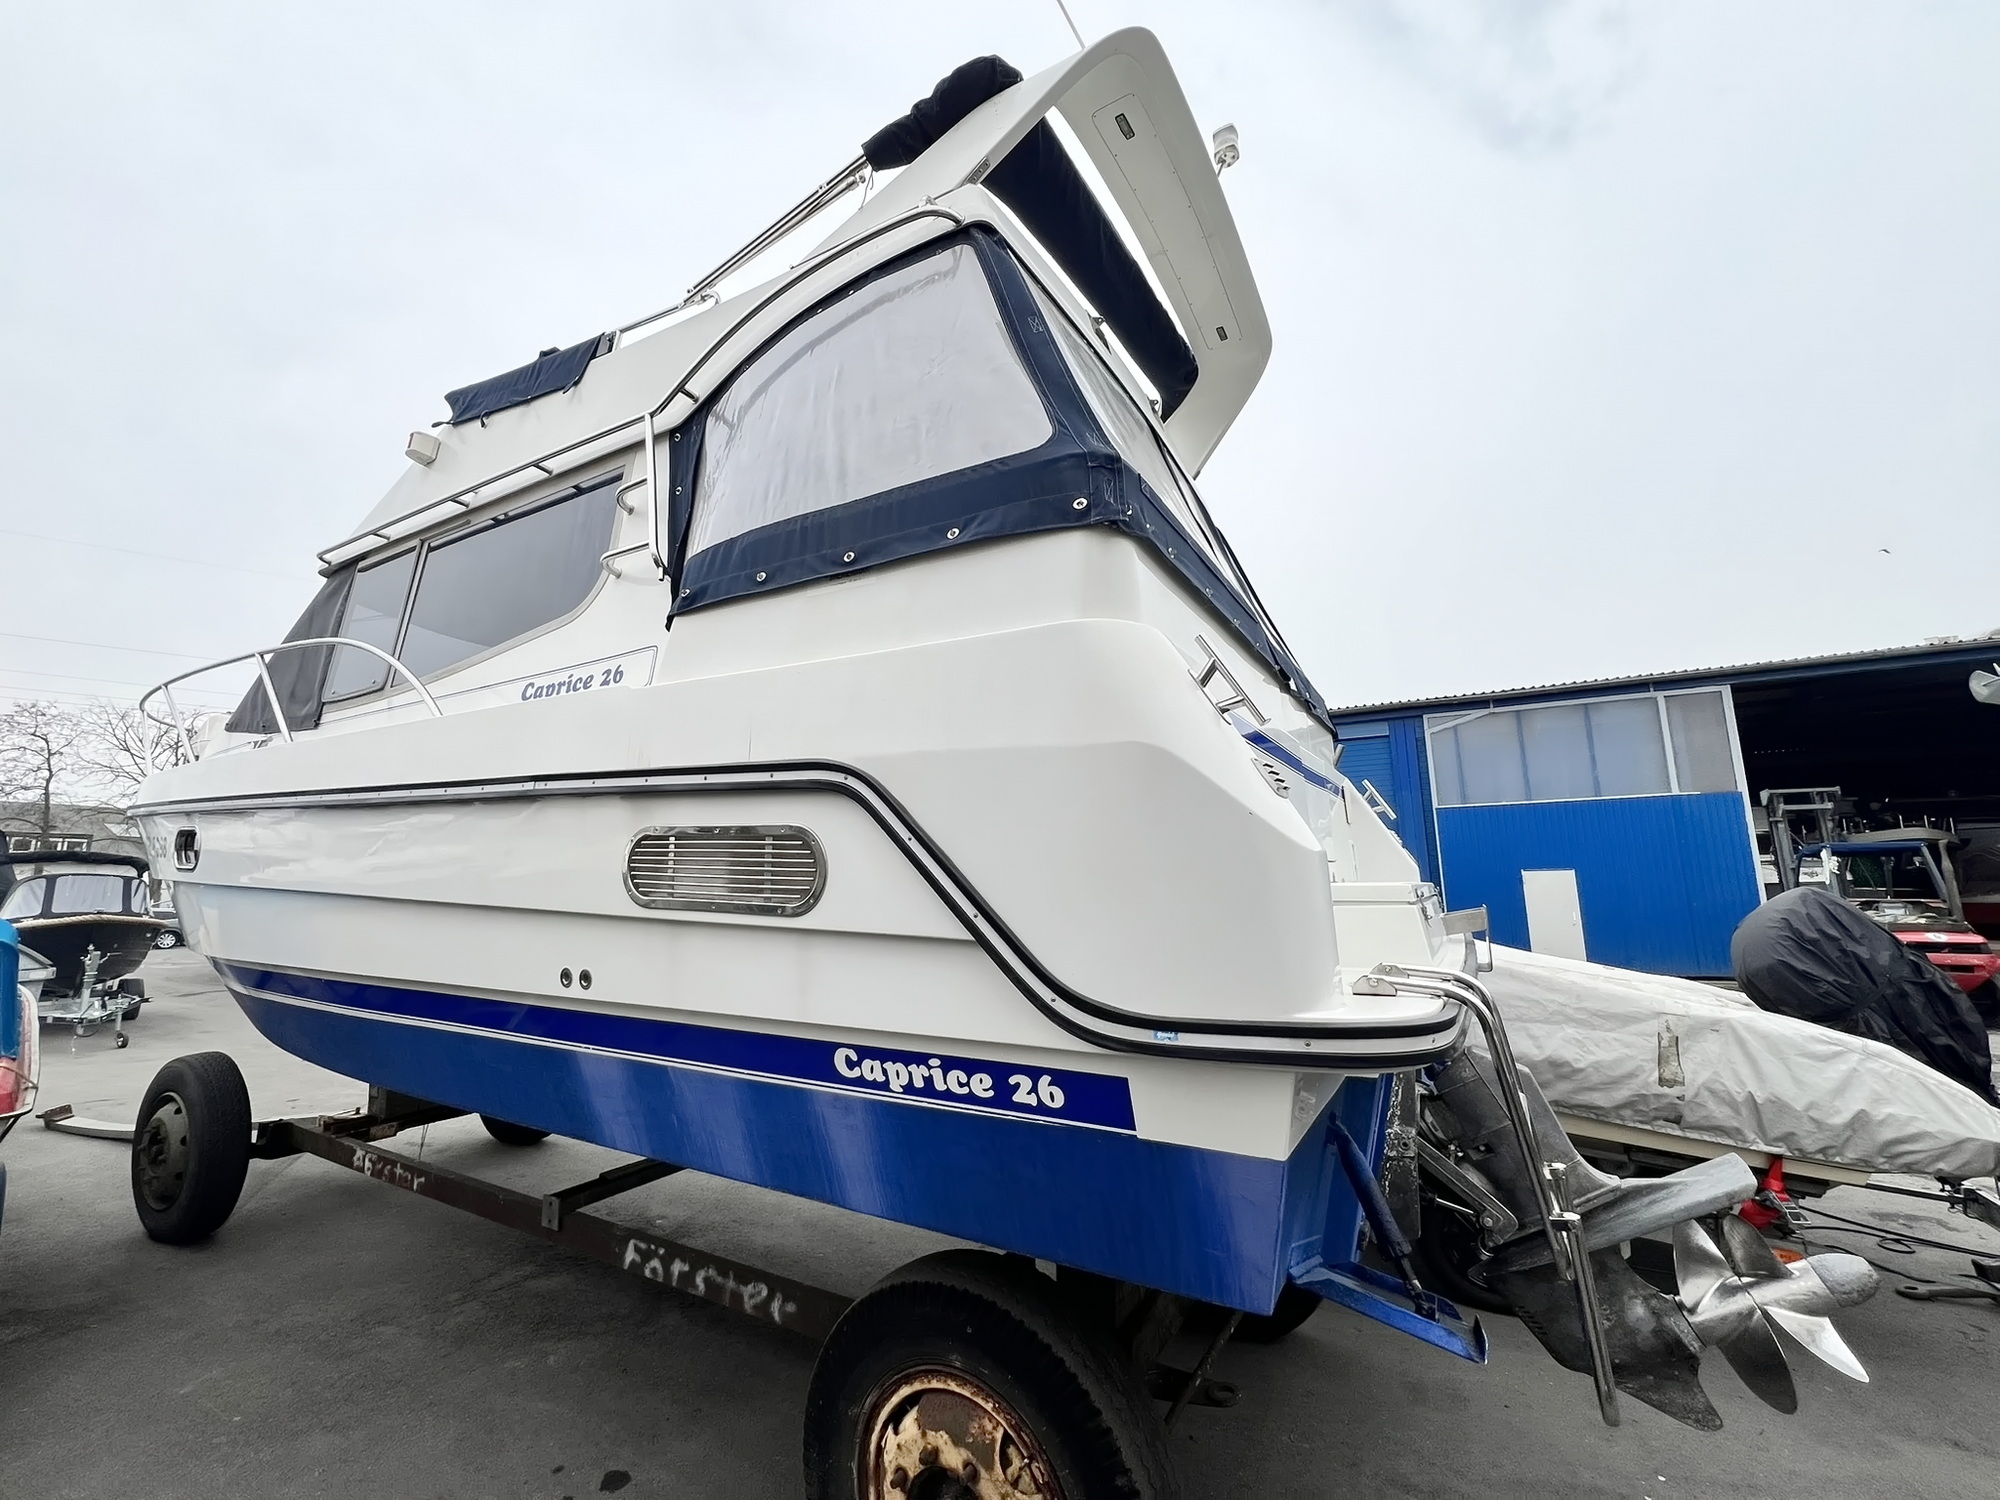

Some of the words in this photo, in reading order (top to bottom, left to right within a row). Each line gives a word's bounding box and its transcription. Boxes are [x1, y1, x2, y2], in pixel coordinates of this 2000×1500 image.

[521, 673, 594, 701] Caprice
[600, 664, 624, 687] 26
[833, 1047, 995, 1098] Caprice
[1007, 1073, 1065, 1109] 26
